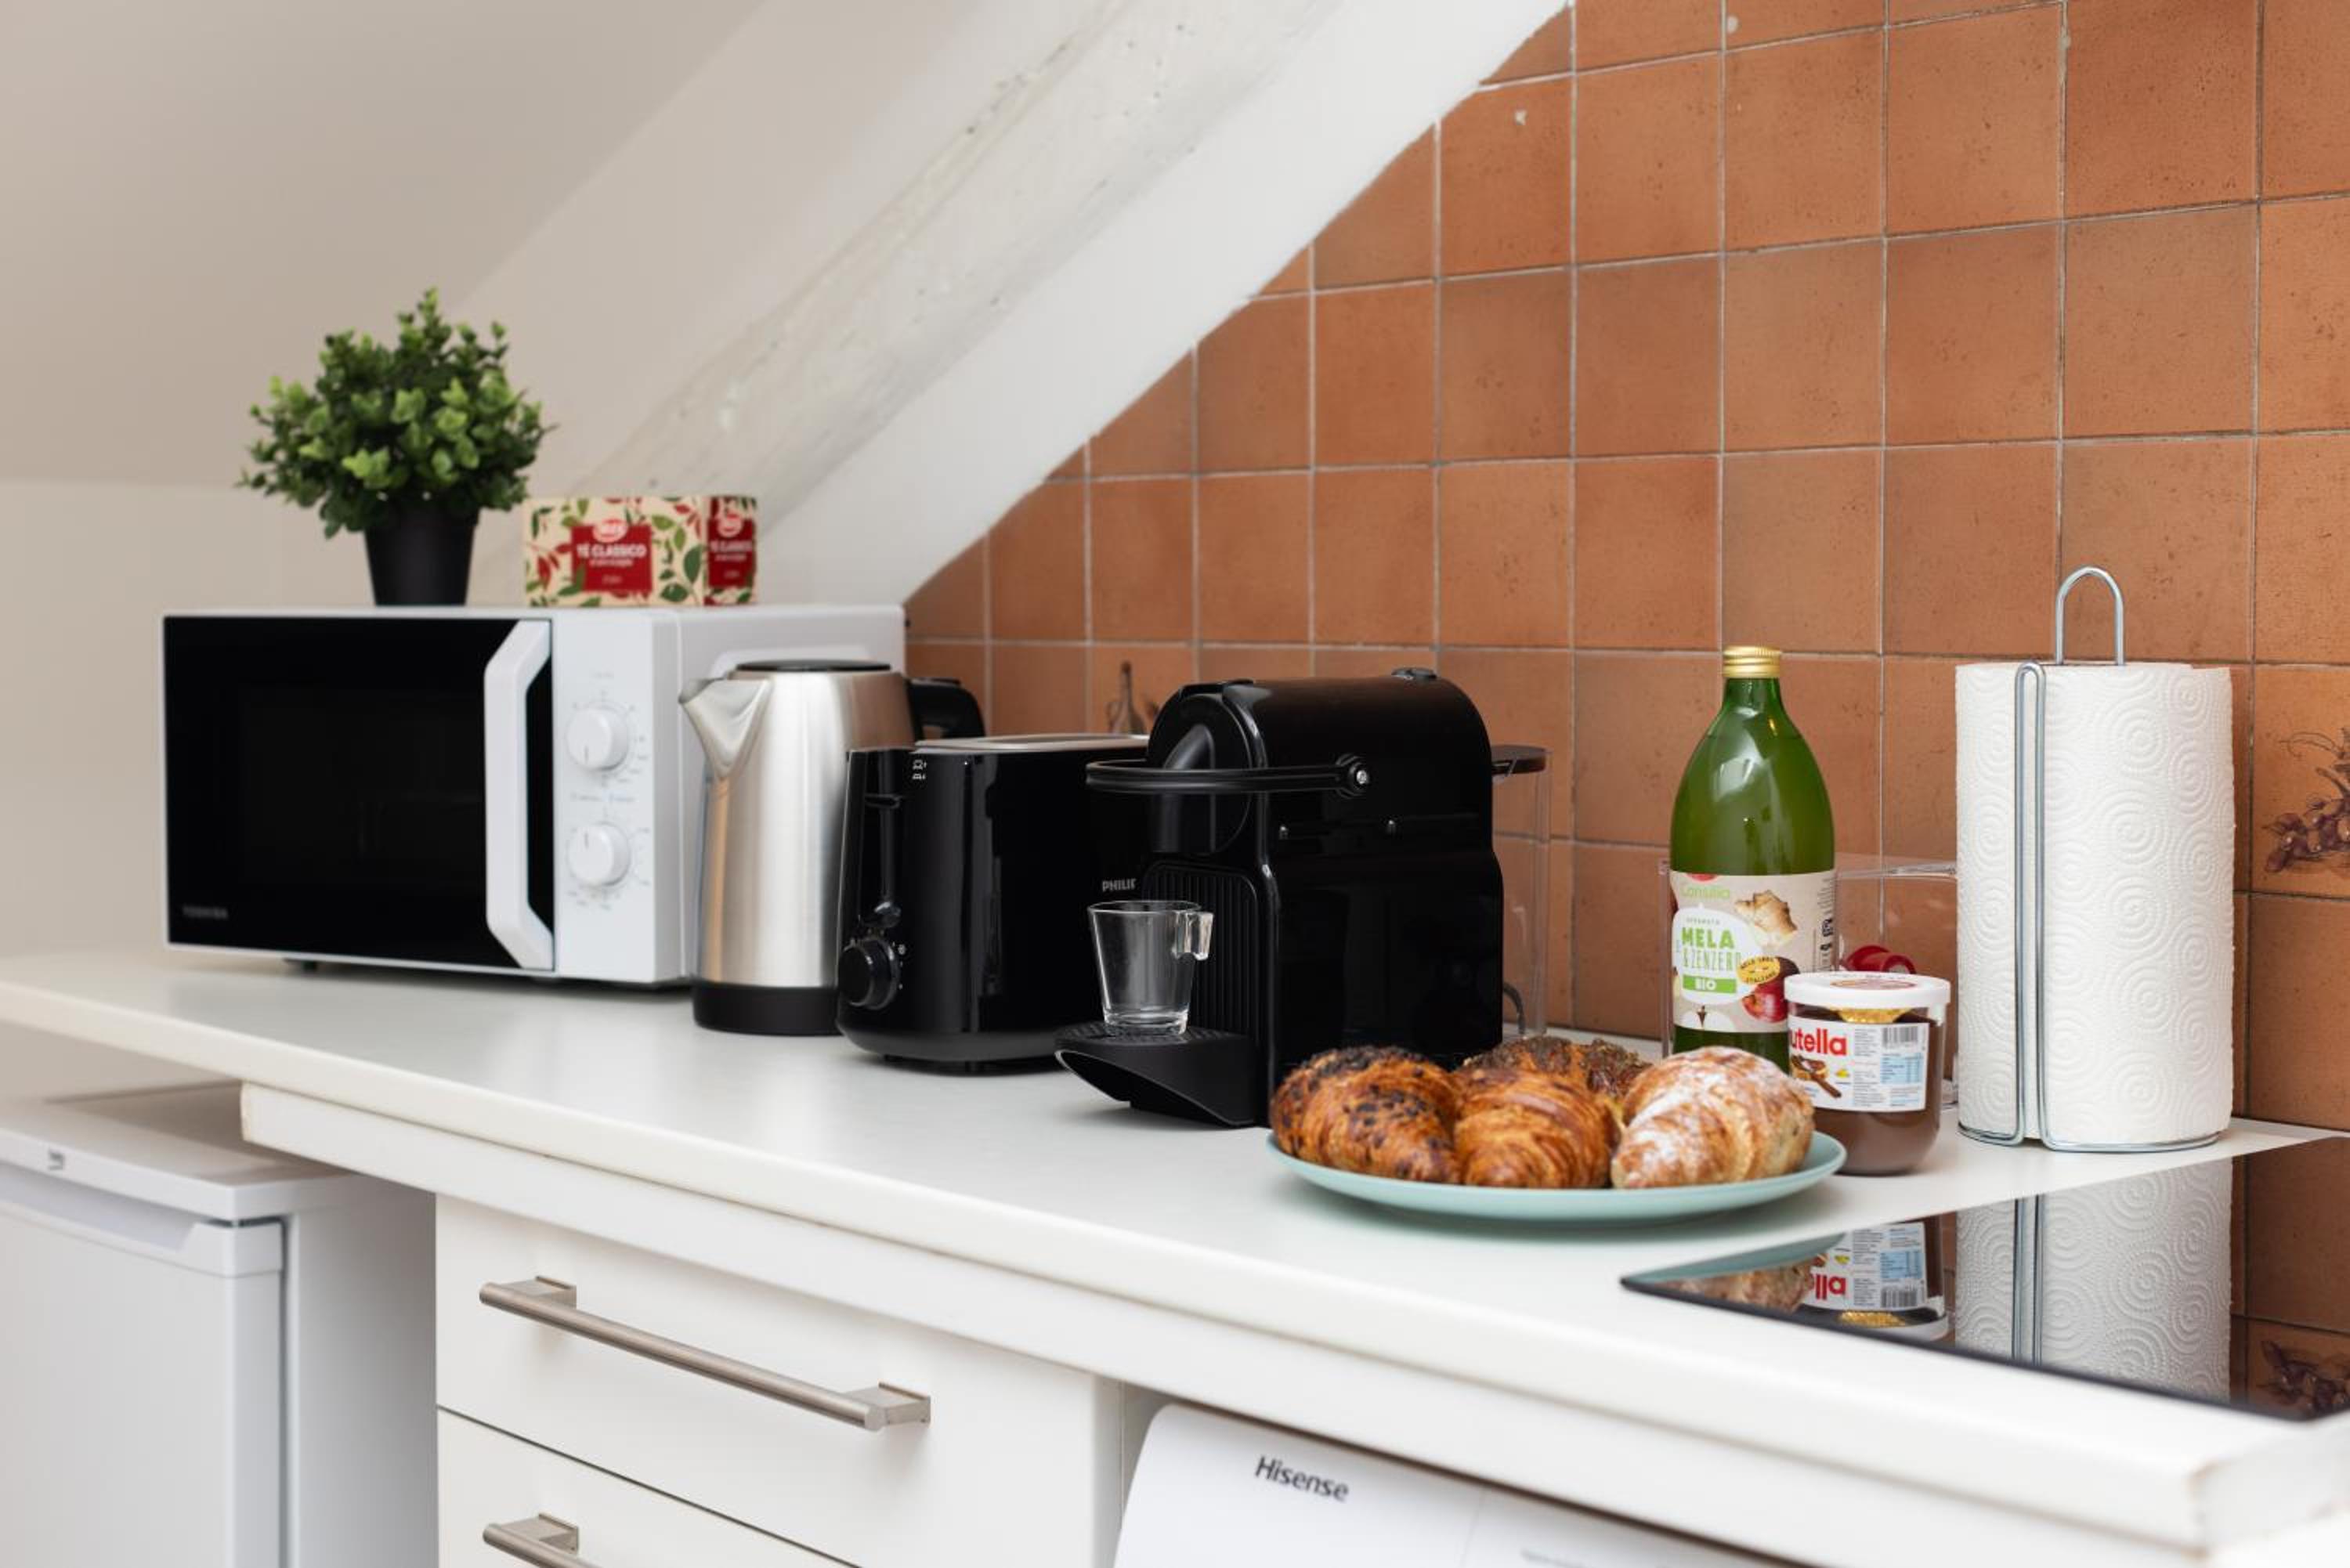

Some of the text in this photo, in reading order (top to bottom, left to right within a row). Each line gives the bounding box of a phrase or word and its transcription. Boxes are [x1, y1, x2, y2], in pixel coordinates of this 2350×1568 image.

[1682, 927, 1734, 949] MELA
[1695, 977, 1717, 991] BIO
[1788, 1028, 1846, 1056] utella
[1255, 1456, 1349, 1502] Hisense
